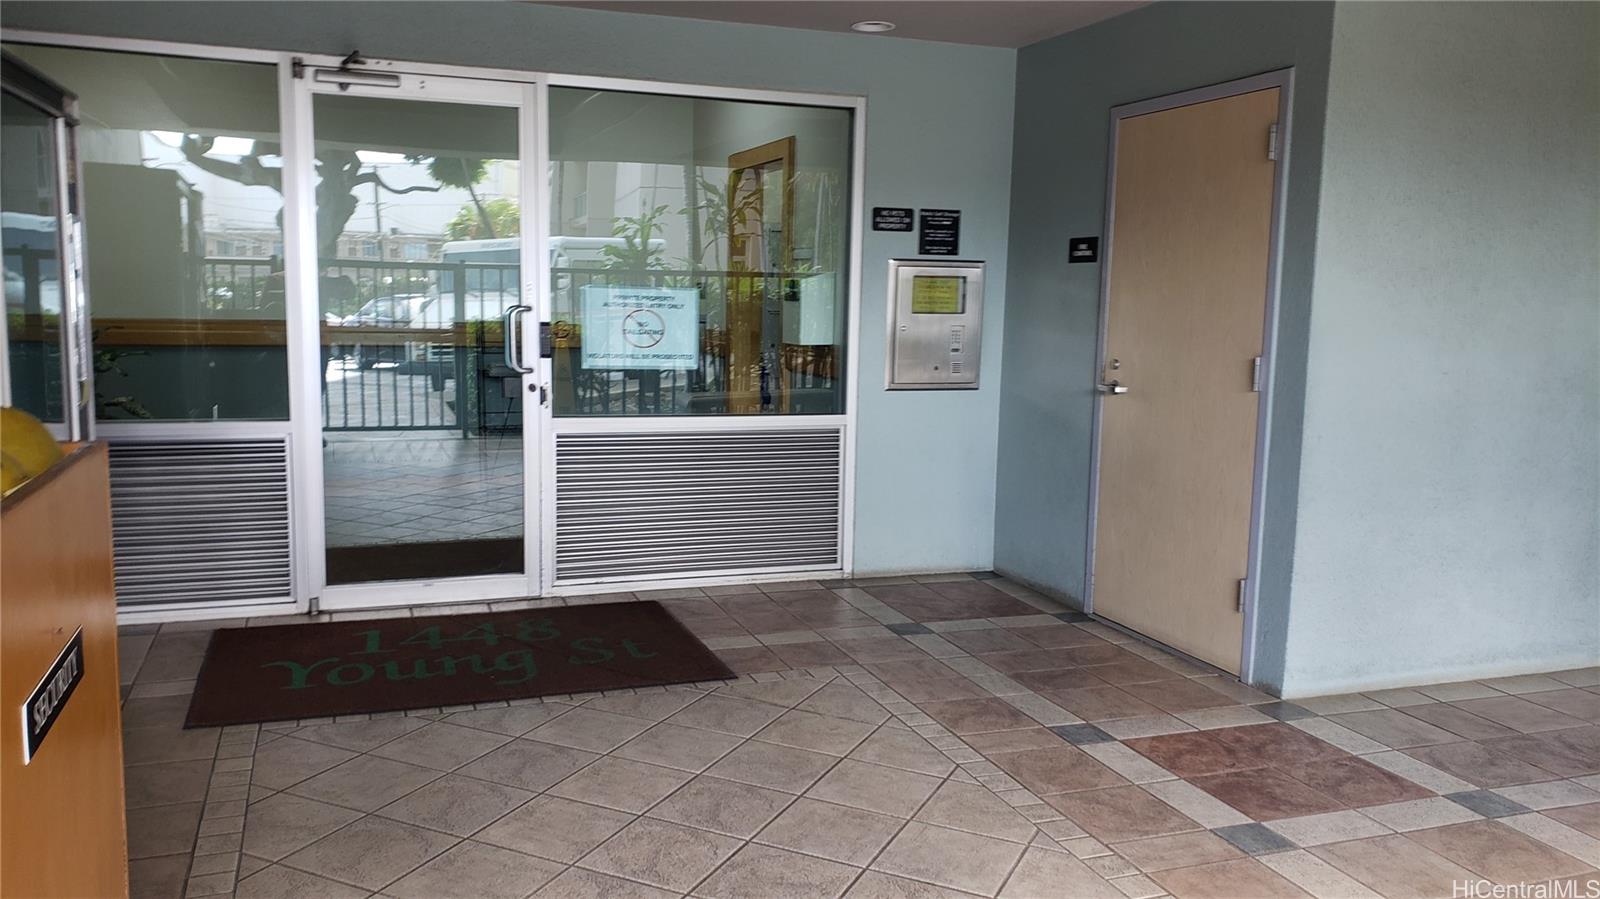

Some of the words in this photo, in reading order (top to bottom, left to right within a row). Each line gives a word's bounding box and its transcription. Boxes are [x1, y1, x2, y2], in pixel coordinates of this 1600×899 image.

[348, 617, 561, 656] 1448
[261, 648, 539, 689] Young
[568, 636, 660, 666] St
